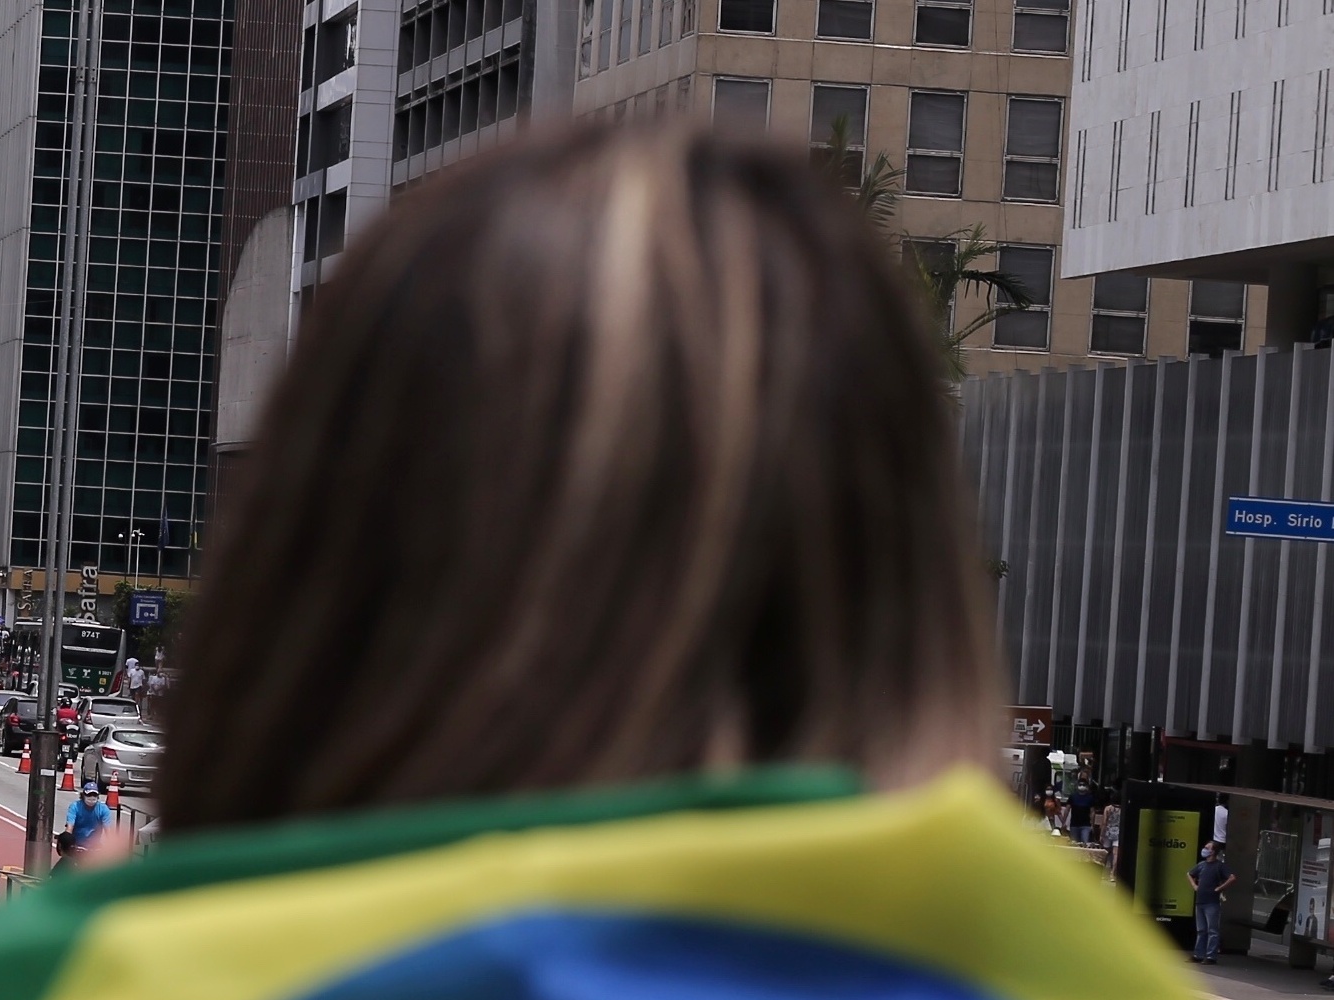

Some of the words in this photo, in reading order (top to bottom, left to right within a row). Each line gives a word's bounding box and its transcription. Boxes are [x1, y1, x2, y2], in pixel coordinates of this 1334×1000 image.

[1234, 510, 1277, 528] Hosp.
[1287, 513, 1322, 528] Sírio
[1149, 838, 1187, 849] Sldão
